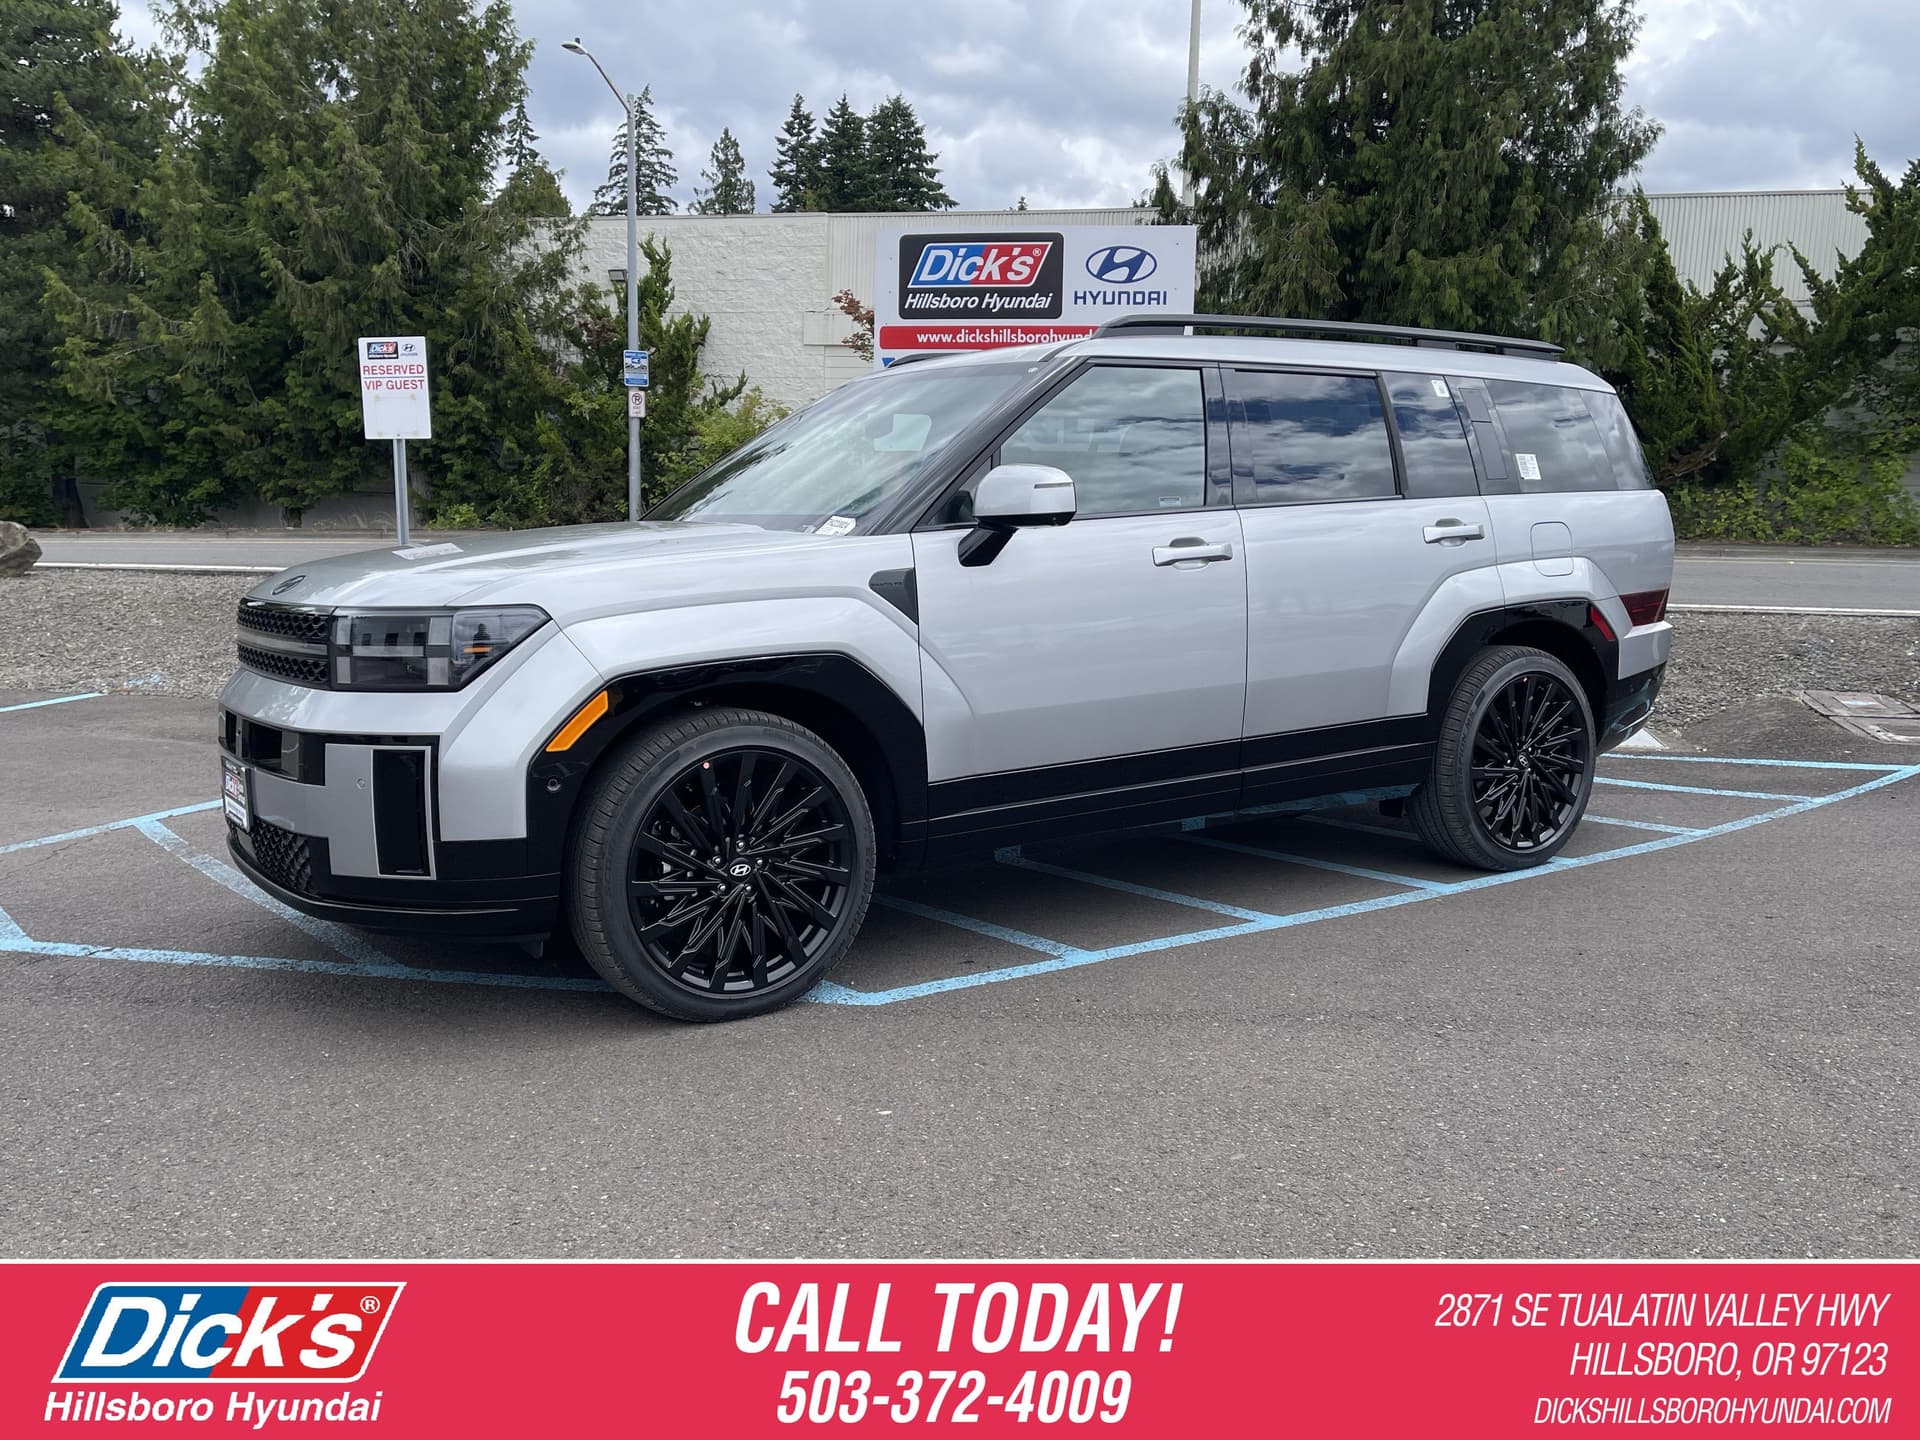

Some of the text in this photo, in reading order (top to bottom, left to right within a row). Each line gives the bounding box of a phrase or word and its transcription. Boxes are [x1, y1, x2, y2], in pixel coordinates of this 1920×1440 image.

[904, 293, 1053, 312] Hillsboro Hyundai
[1073, 290, 1167, 306] HYUNDAI
[362, 364, 425, 376] RESERVED
[364, 379, 425, 391] VIP GUEST
